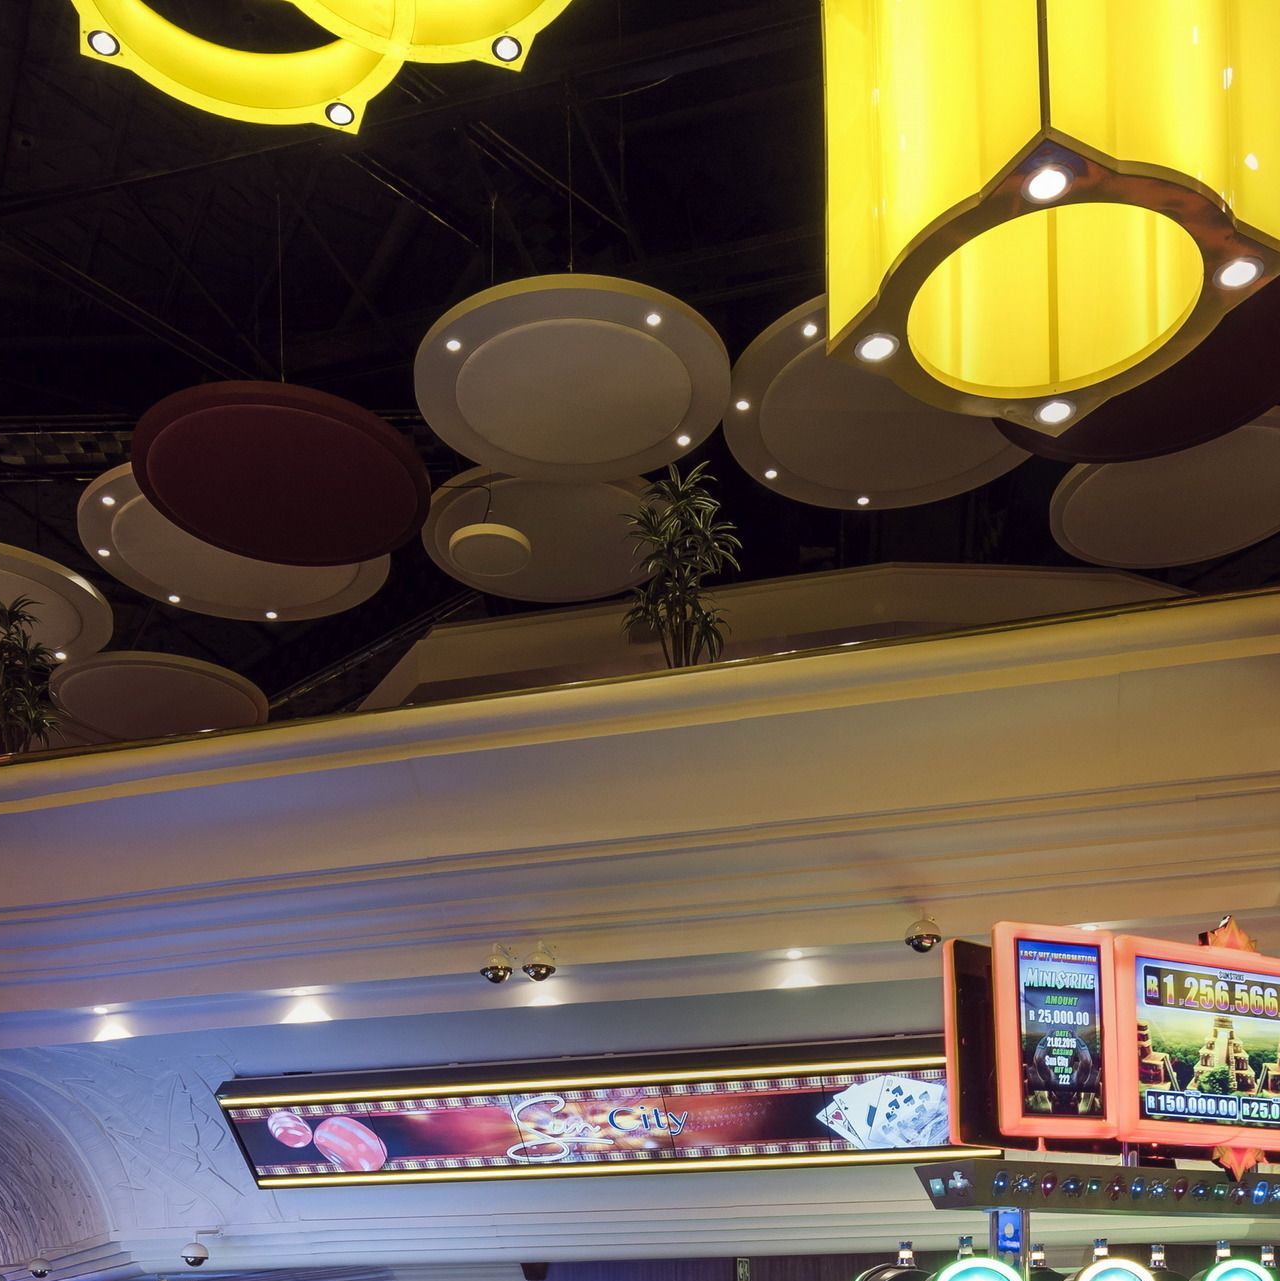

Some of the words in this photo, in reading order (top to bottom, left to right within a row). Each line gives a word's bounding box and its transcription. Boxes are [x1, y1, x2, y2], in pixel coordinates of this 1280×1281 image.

[1146, 975, 1159, 998] R
[1044, 995, 1078, 1006] AMOUNT
[1029, 1010, 1035, 1021] R
[1038, 1009, 1090, 1025] 25,000.00
[1045, 1055, 1057, 1066] Sun
[1057, 1056, 1069, 1067] City
[1058, 1075, 1070, 1085] 222
[1148, 1096, 1155, 1108] R
[1158, 1095, 1237, 1116] 150,000.00
[1243, 1103, 1250, 1116] R
[507, 1095, 614, 1162] Sun
[608, 1106, 688, 1136] City
